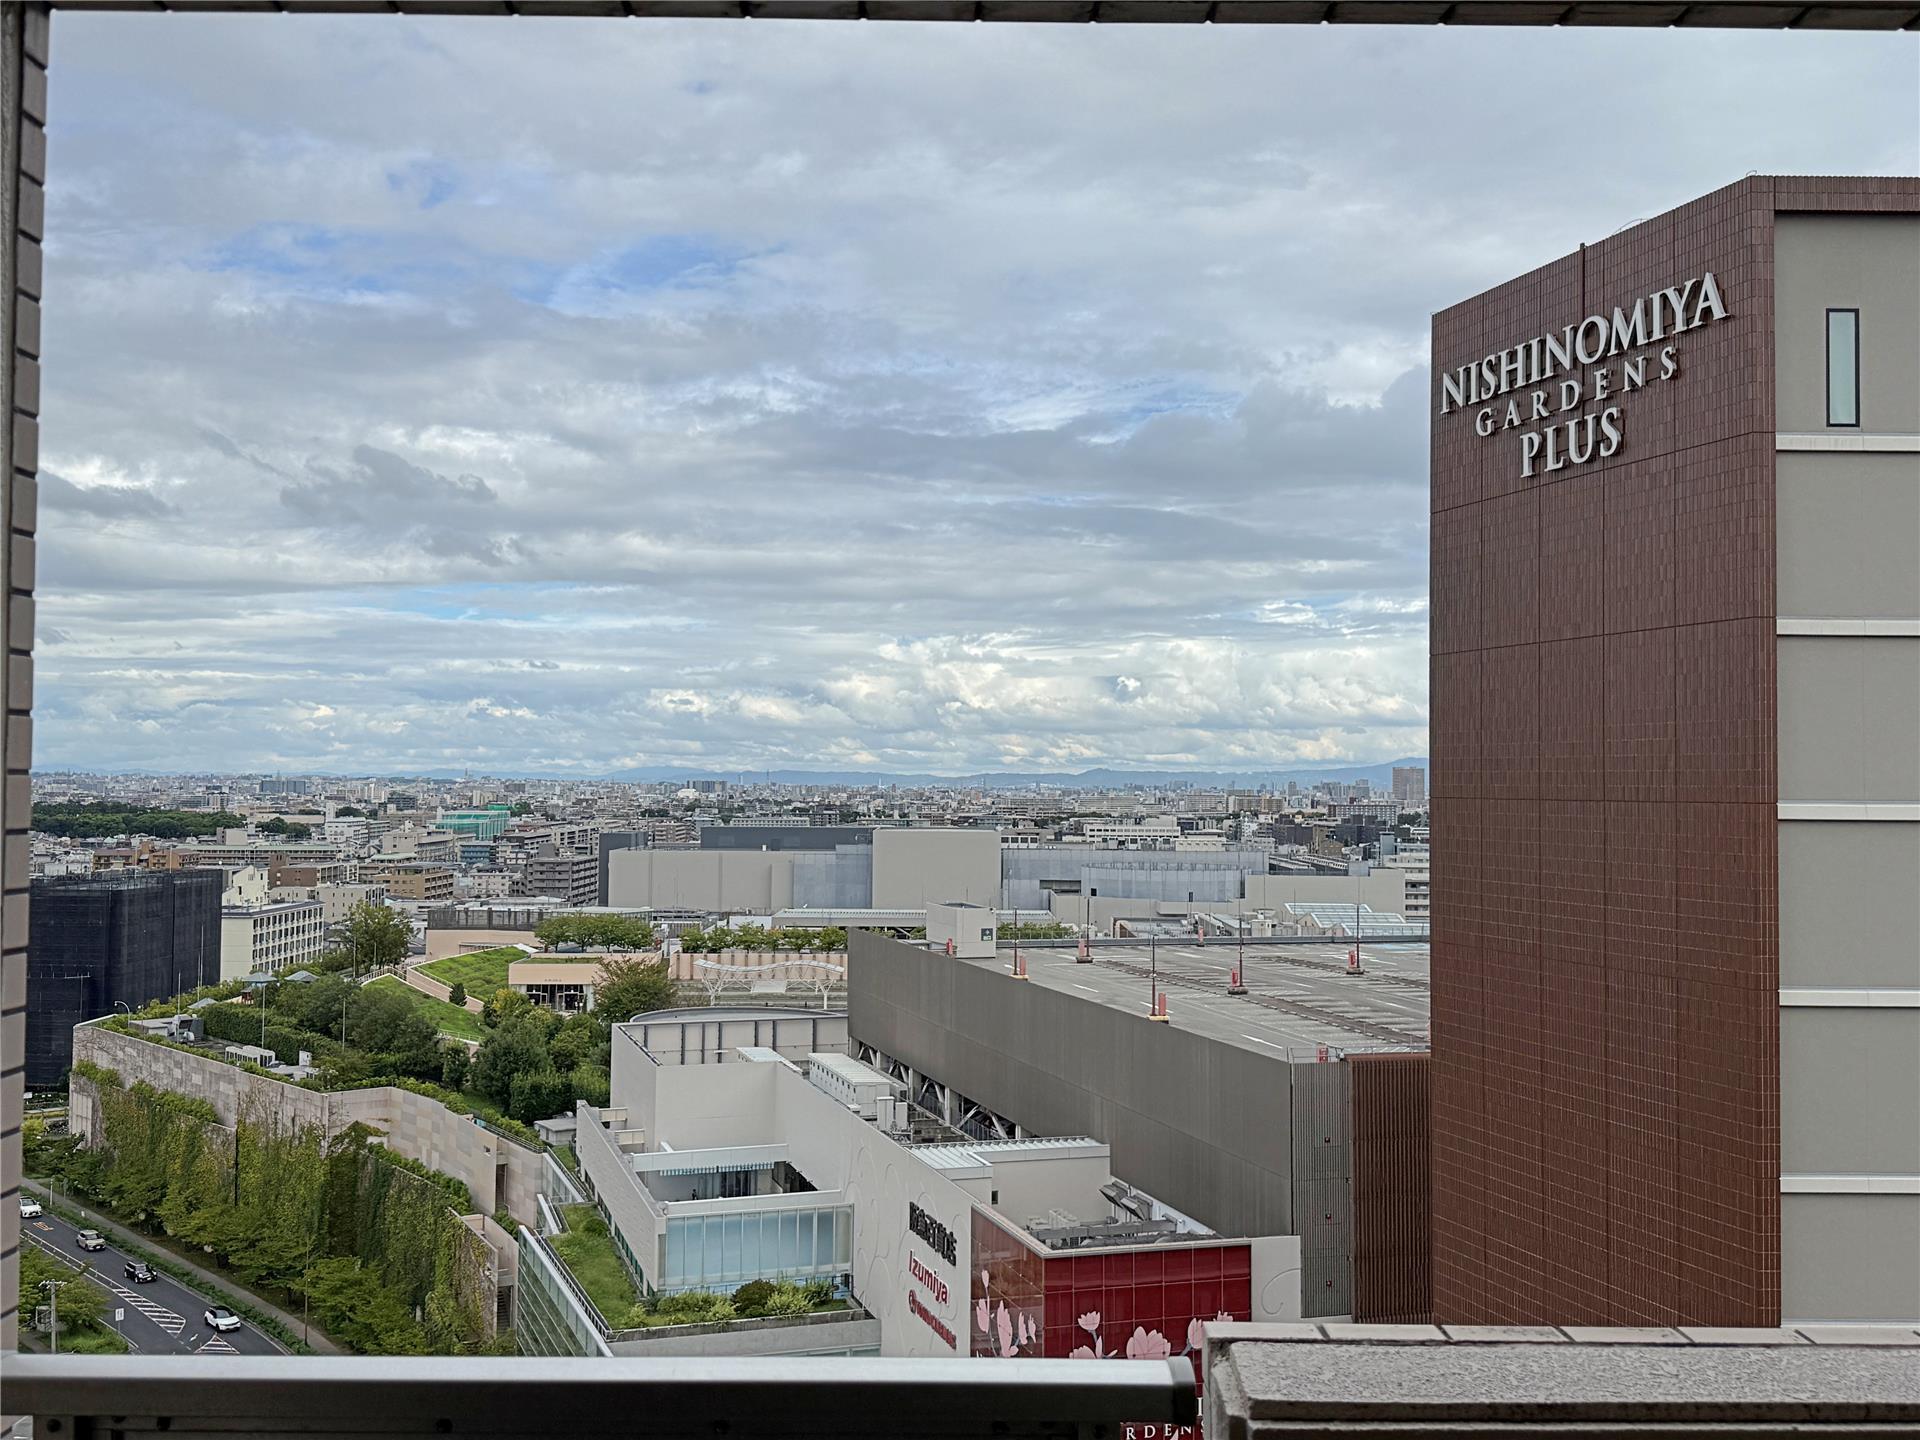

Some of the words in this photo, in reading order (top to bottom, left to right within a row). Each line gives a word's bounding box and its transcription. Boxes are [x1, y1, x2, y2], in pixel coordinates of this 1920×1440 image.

[1440, 271, 1731, 414] NISHINOMIYA
[1475, 346, 1678, 437] GARDENS
[1520, 406, 1622, 478] PLUS
[908, 1250, 949, 1304] Izumiya
